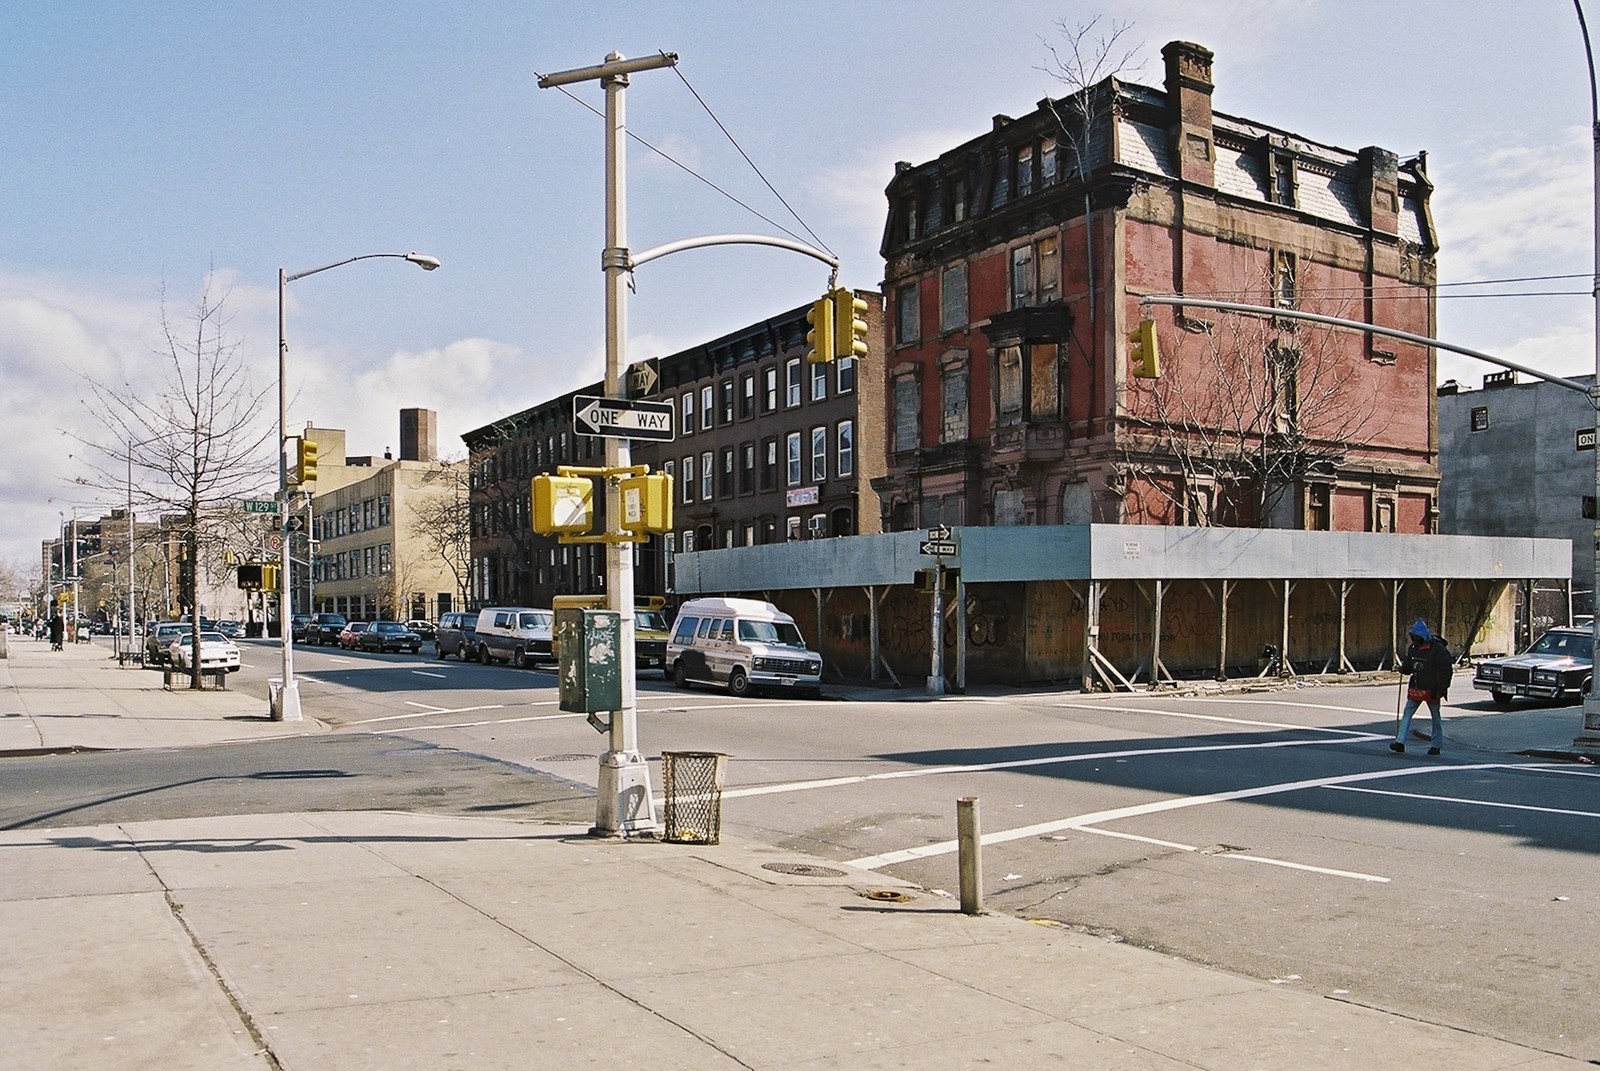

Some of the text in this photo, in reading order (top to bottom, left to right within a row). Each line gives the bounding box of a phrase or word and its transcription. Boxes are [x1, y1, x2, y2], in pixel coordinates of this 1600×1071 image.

[590, 409, 666, 429] ONE WAY
[1580, 435, 1595, 445] ON
[245, 501, 253, 512] W
[255, 501, 269, 513] 129
